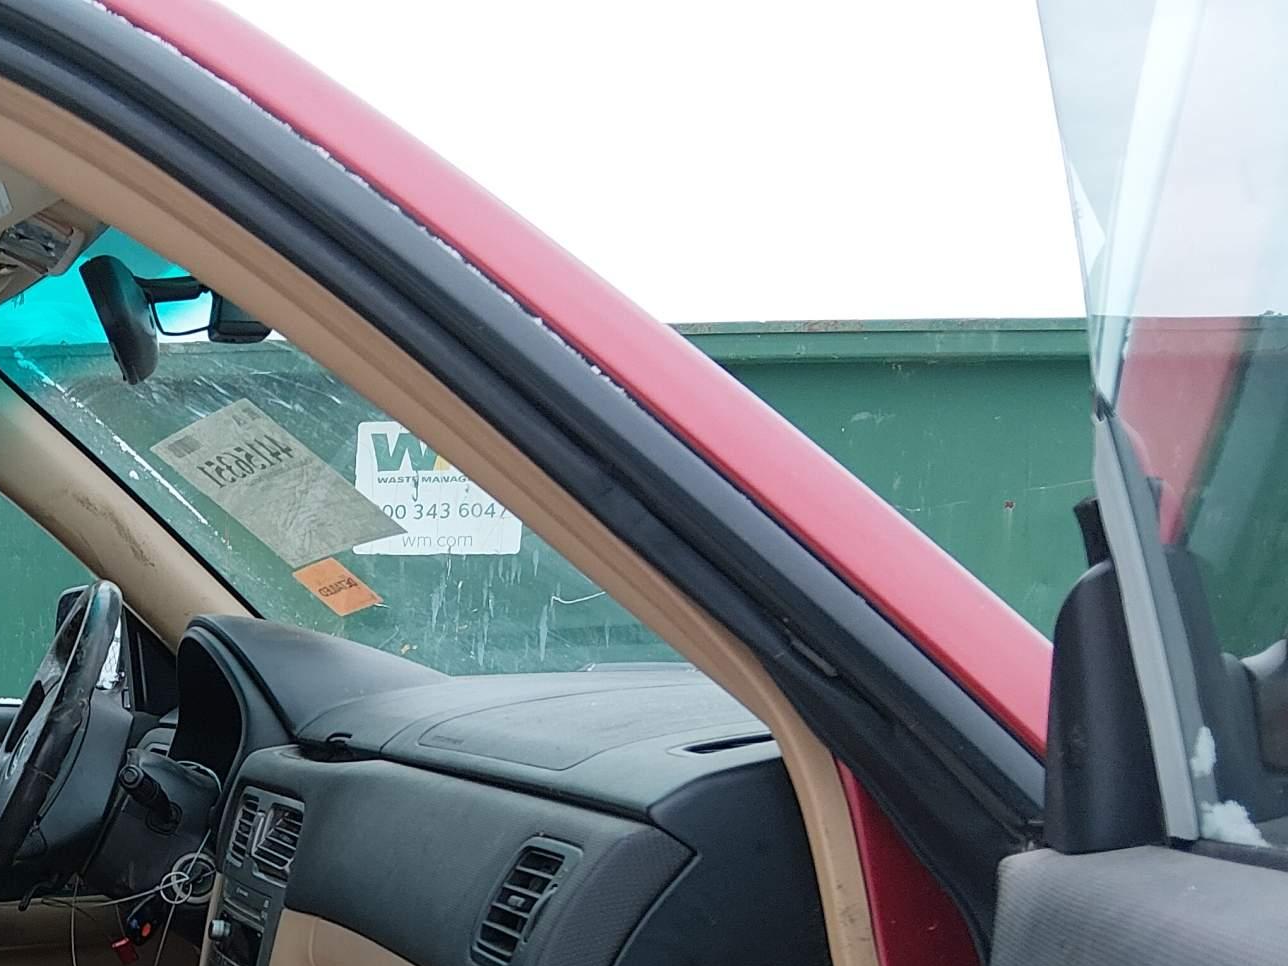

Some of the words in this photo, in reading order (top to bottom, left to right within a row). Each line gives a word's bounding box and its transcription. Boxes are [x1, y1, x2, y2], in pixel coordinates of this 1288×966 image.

[370, 432, 450, 472] W
[421, 475, 469, 484] MANAG
[382, 503, 407, 520] 00
[412, 502, 451, 520] 343
[401, 535, 473, 548] wmcom
